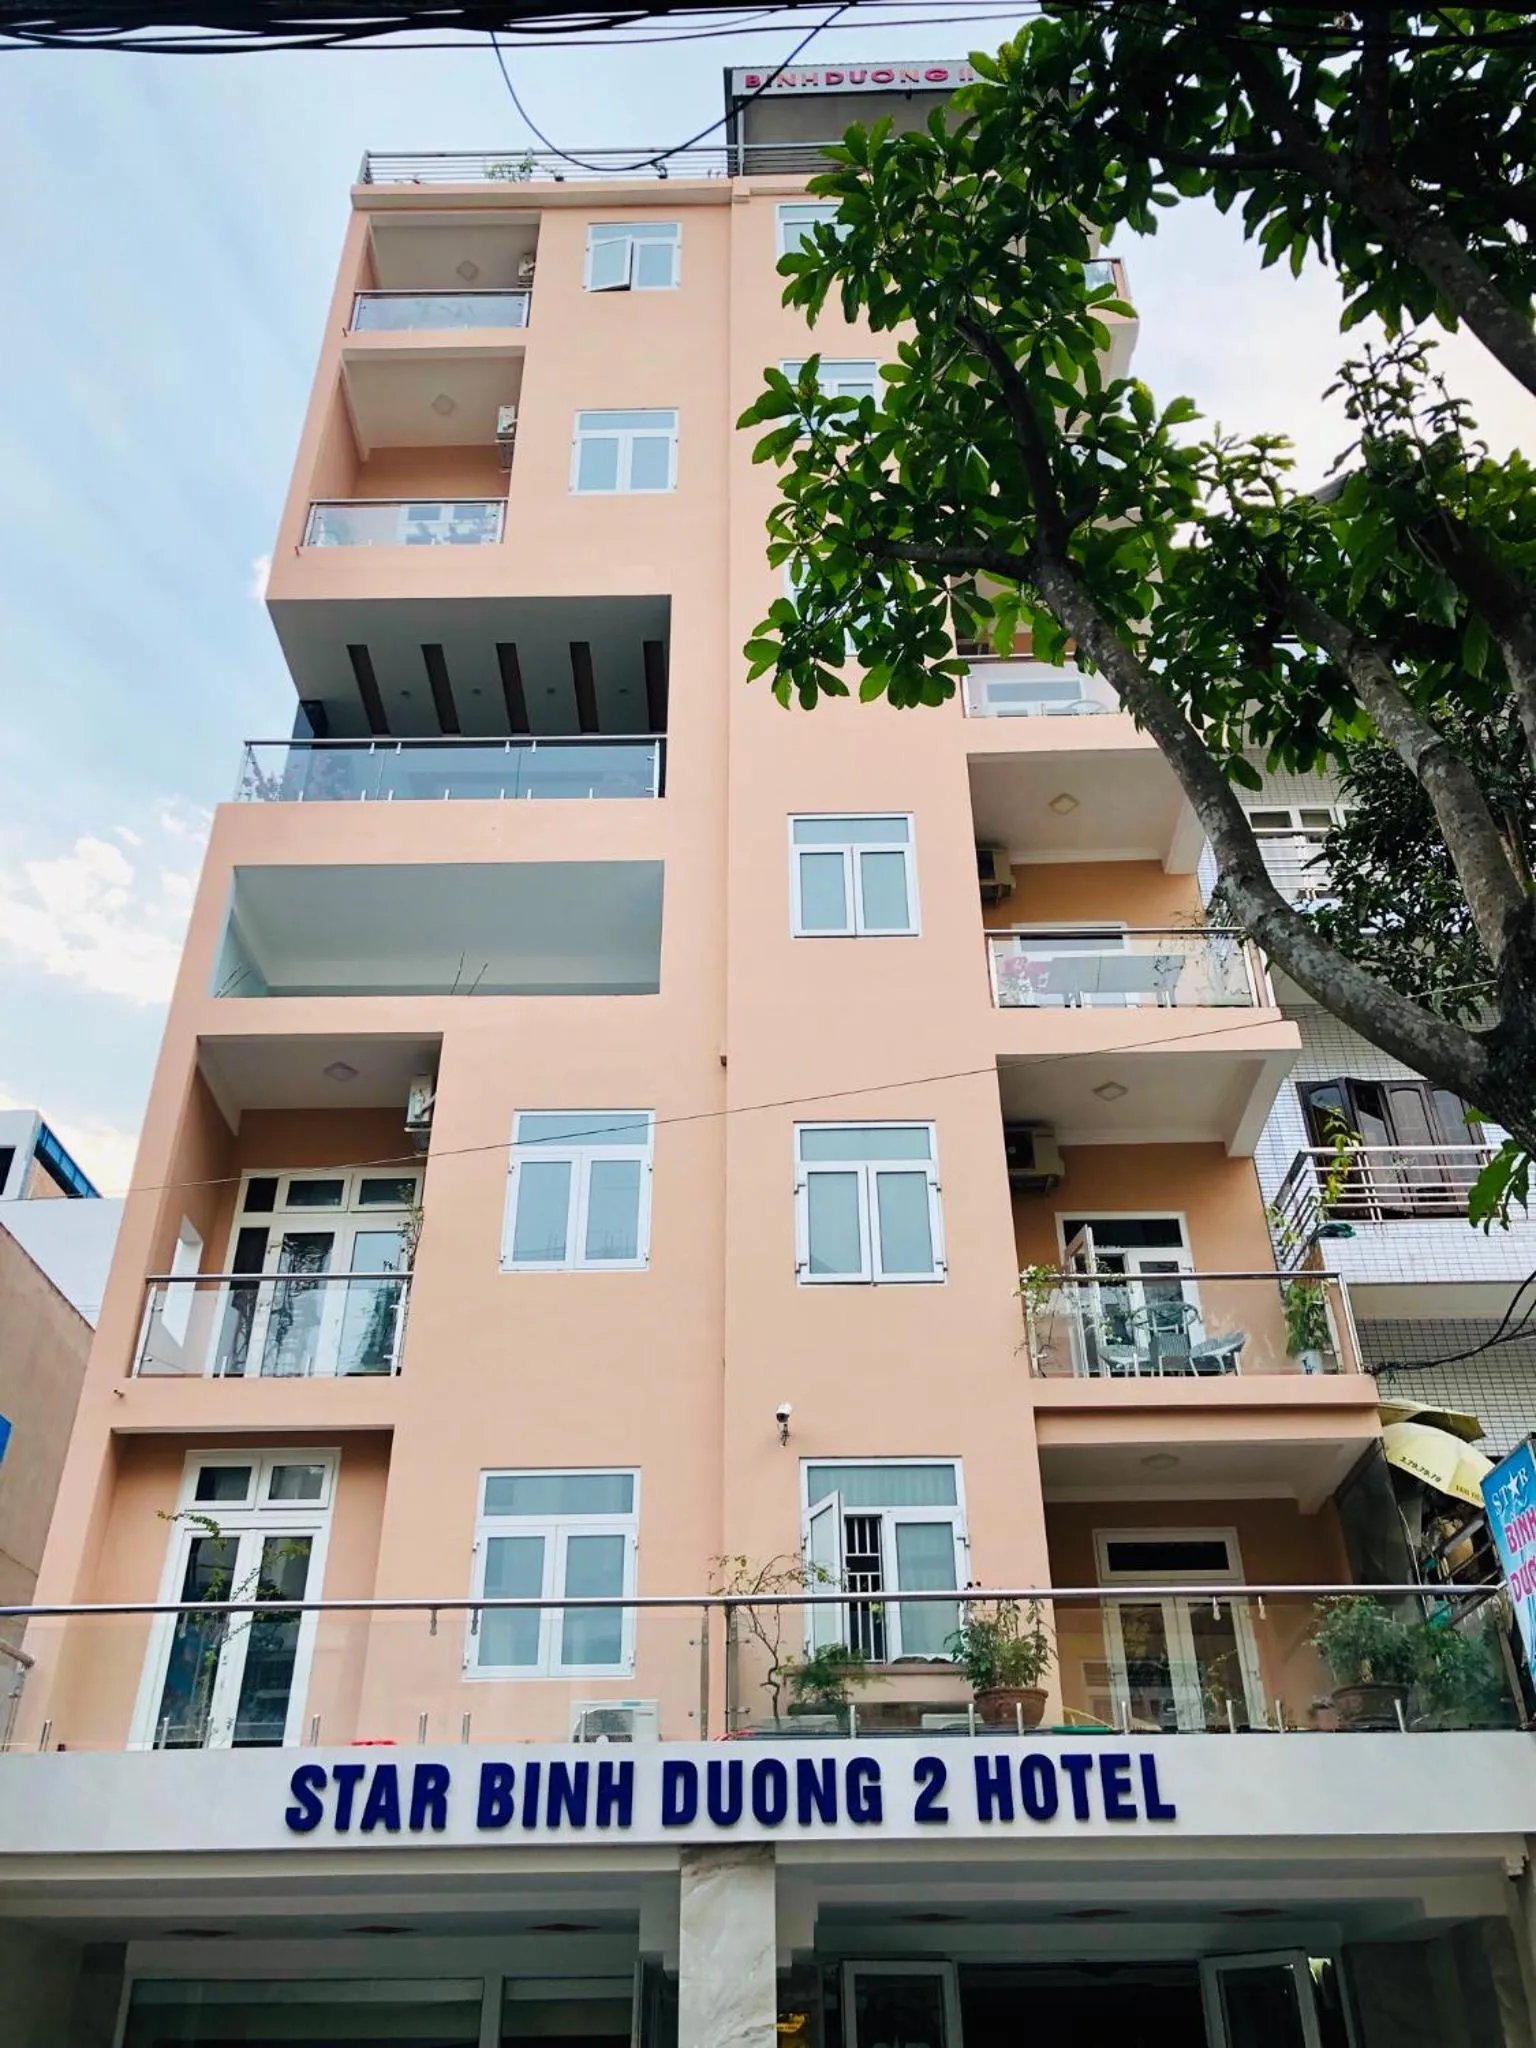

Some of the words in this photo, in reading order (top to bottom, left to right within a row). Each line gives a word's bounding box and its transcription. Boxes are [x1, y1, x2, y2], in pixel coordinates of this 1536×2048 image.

[285, 1763, 449, 1833] STAR
[476, 1761, 634, 1830] BINH
[661, 1756, 883, 1828] DUONG
[913, 1756, 949, 1824] 2
[974, 1753, 1177, 1822] HOTEL
